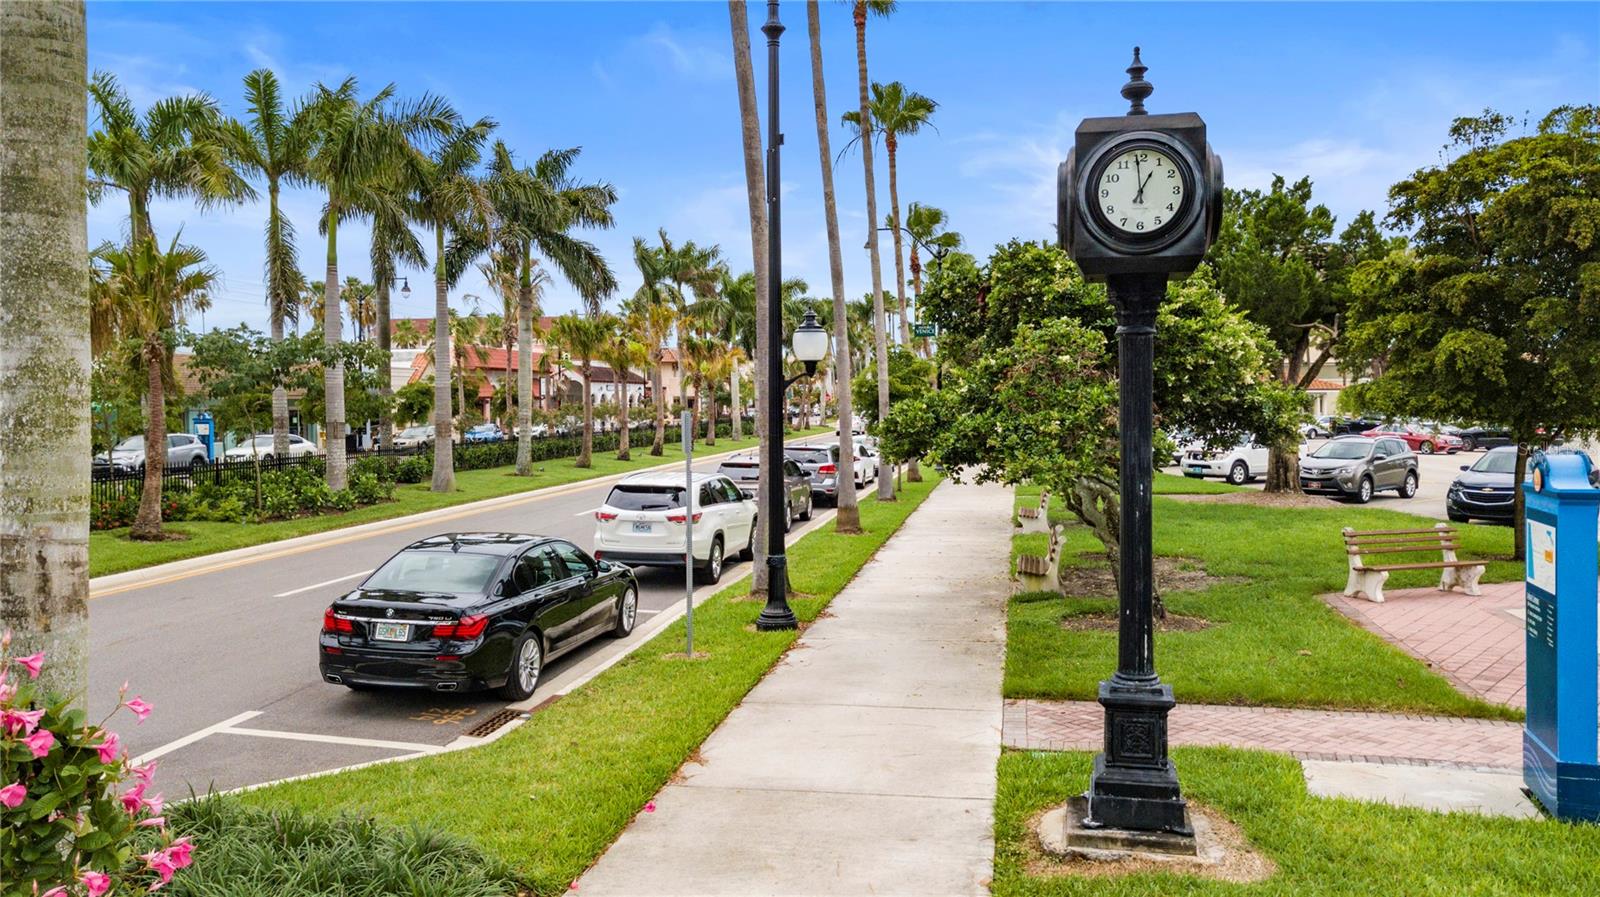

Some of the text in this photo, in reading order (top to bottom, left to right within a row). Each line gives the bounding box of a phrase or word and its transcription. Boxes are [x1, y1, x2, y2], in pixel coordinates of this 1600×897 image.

[1133, 153, 1148, 163] 12
[1156, 157, 1162, 166] 1
[1118, 160, 1130, 169] 11
[1167, 169, 1176, 178] 2
[1105, 174, 1120, 183] 10
[1101, 189, 1109, 198] 9
[1172, 185, 1181, 195] 3
[1106, 205, 1114, 214] 8
[1166, 203, 1174, 211] 4
[1120, 217, 1128, 227] 7
[1154, 216, 1162, 225] 5
[1136, 221, 1144, 230] 6
